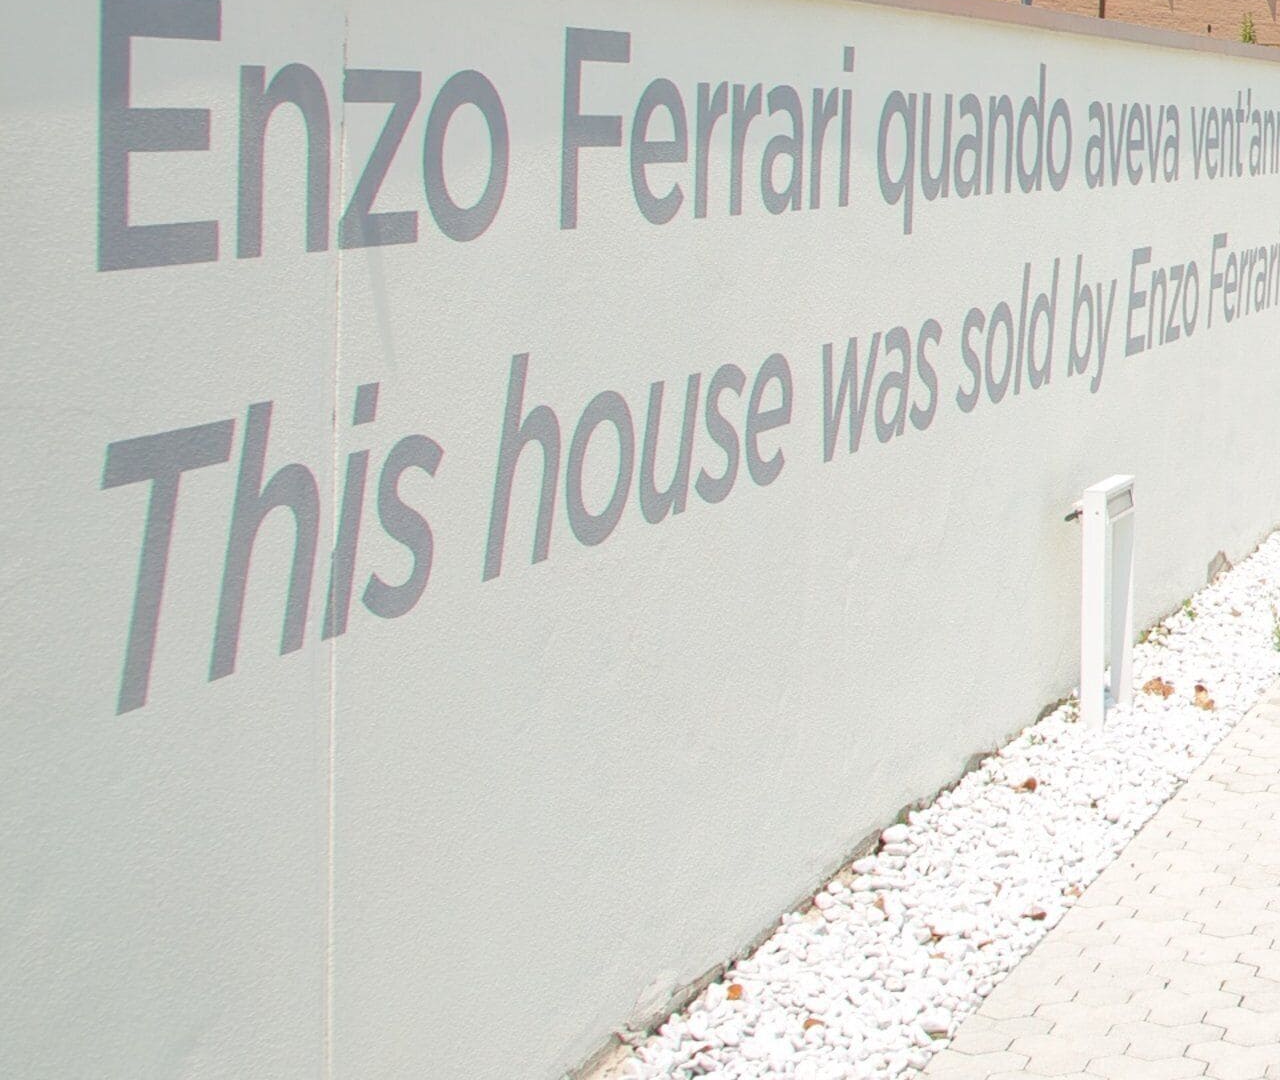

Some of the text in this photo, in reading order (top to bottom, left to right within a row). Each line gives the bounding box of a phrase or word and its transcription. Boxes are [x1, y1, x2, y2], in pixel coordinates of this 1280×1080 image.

[559, 26, 856, 231] Ferrari
[876, 62, 1073, 235] quando
[1084, 100, 1180, 190] aveva
[99, 381, 445, 717] This
[481, 351, 794, 583] house
[822, 318, 943, 464] was
[955, 257, 1061, 411] sold
[1067, 253, 1118, 394] by
[1124, 245, 1200, 358] Enzo
